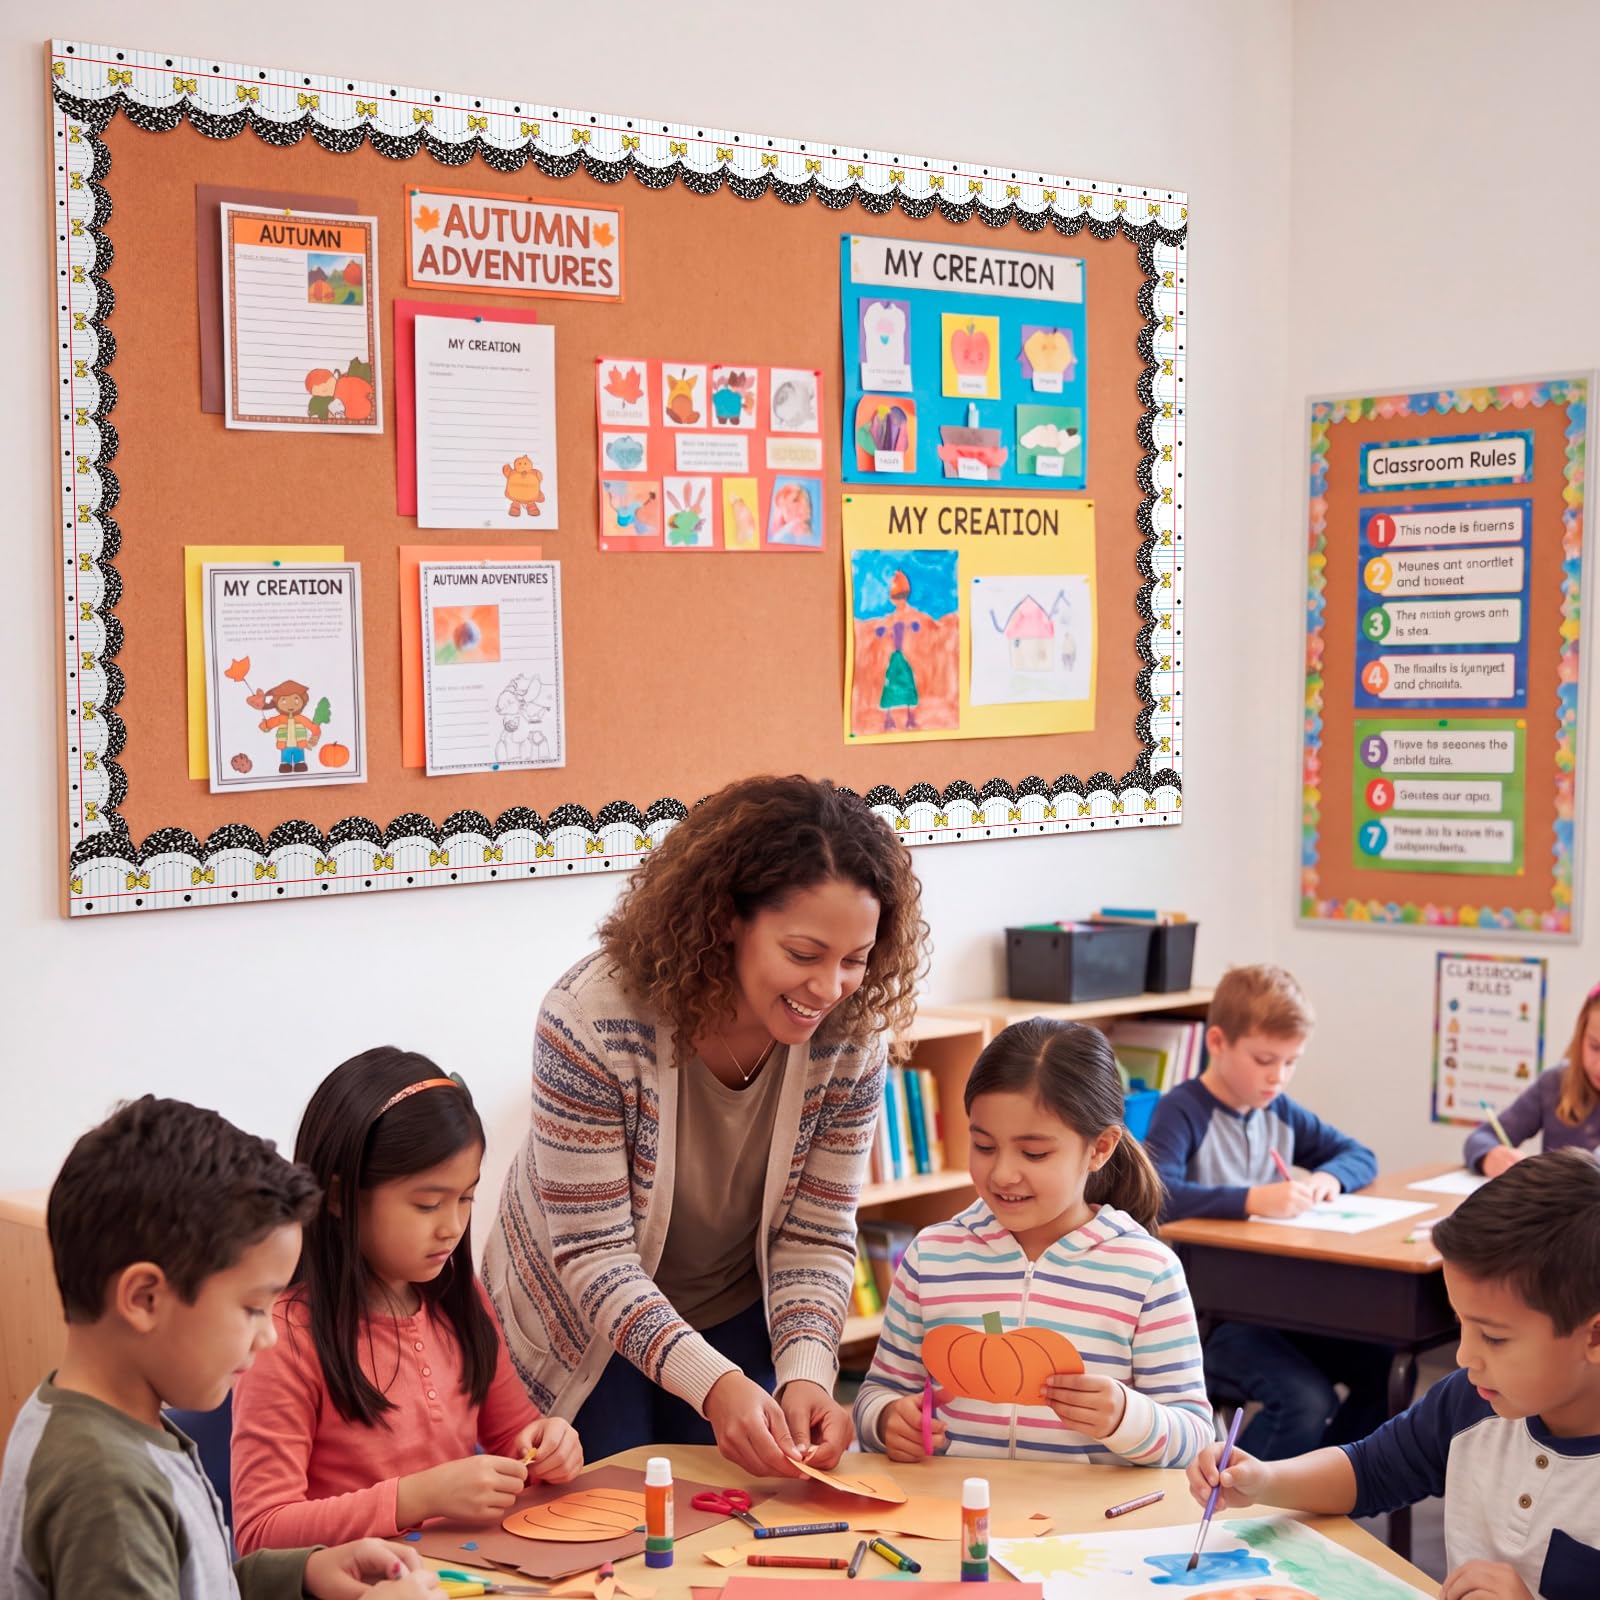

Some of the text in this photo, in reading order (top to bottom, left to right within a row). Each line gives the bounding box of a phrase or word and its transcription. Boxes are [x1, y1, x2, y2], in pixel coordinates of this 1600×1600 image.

[260, 224, 341, 249] AUTUMN
[443, 203, 590, 249] AUTUMN
[417, 244, 613, 288] ADVENTURES
[884, 248, 1055, 291] MY CREATION
[448, 337, 521, 353] MY CREATION
[1373, 449, 1517, 475] Classroom Rules
[888, 505, 1059, 536] MY CREATION
[1376, 519, 1385, 544] 1
[1400, 525, 1421, 536] This
[1460, 522, 1469, 533] is
[433, 573, 548, 586] AUTUMN ADVENTURES
[1371, 562, 1386, 586] 2
[1396, 576, 1420, 587] and
[223, 578, 343, 597] MY CREATION
[1369, 612, 1384, 637] 3
[1454, 609, 1485, 622] grows
[1396, 626, 1404, 637] is
[1368, 666, 1383, 688] 4
[1394, 663, 1410, 674] The
[1449, 662, 1458, 673] is
[1394, 679, 1415, 690] and
[1367, 740, 1381, 763] 5
[1489, 739, 1508, 750] the
[1372, 783, 1387, 806] 6
[1367, 826, 1381, 849] 7
[1446, 963, 1533, 981] CLASSROOM
[1466, 980, 1512, 997] RULES
